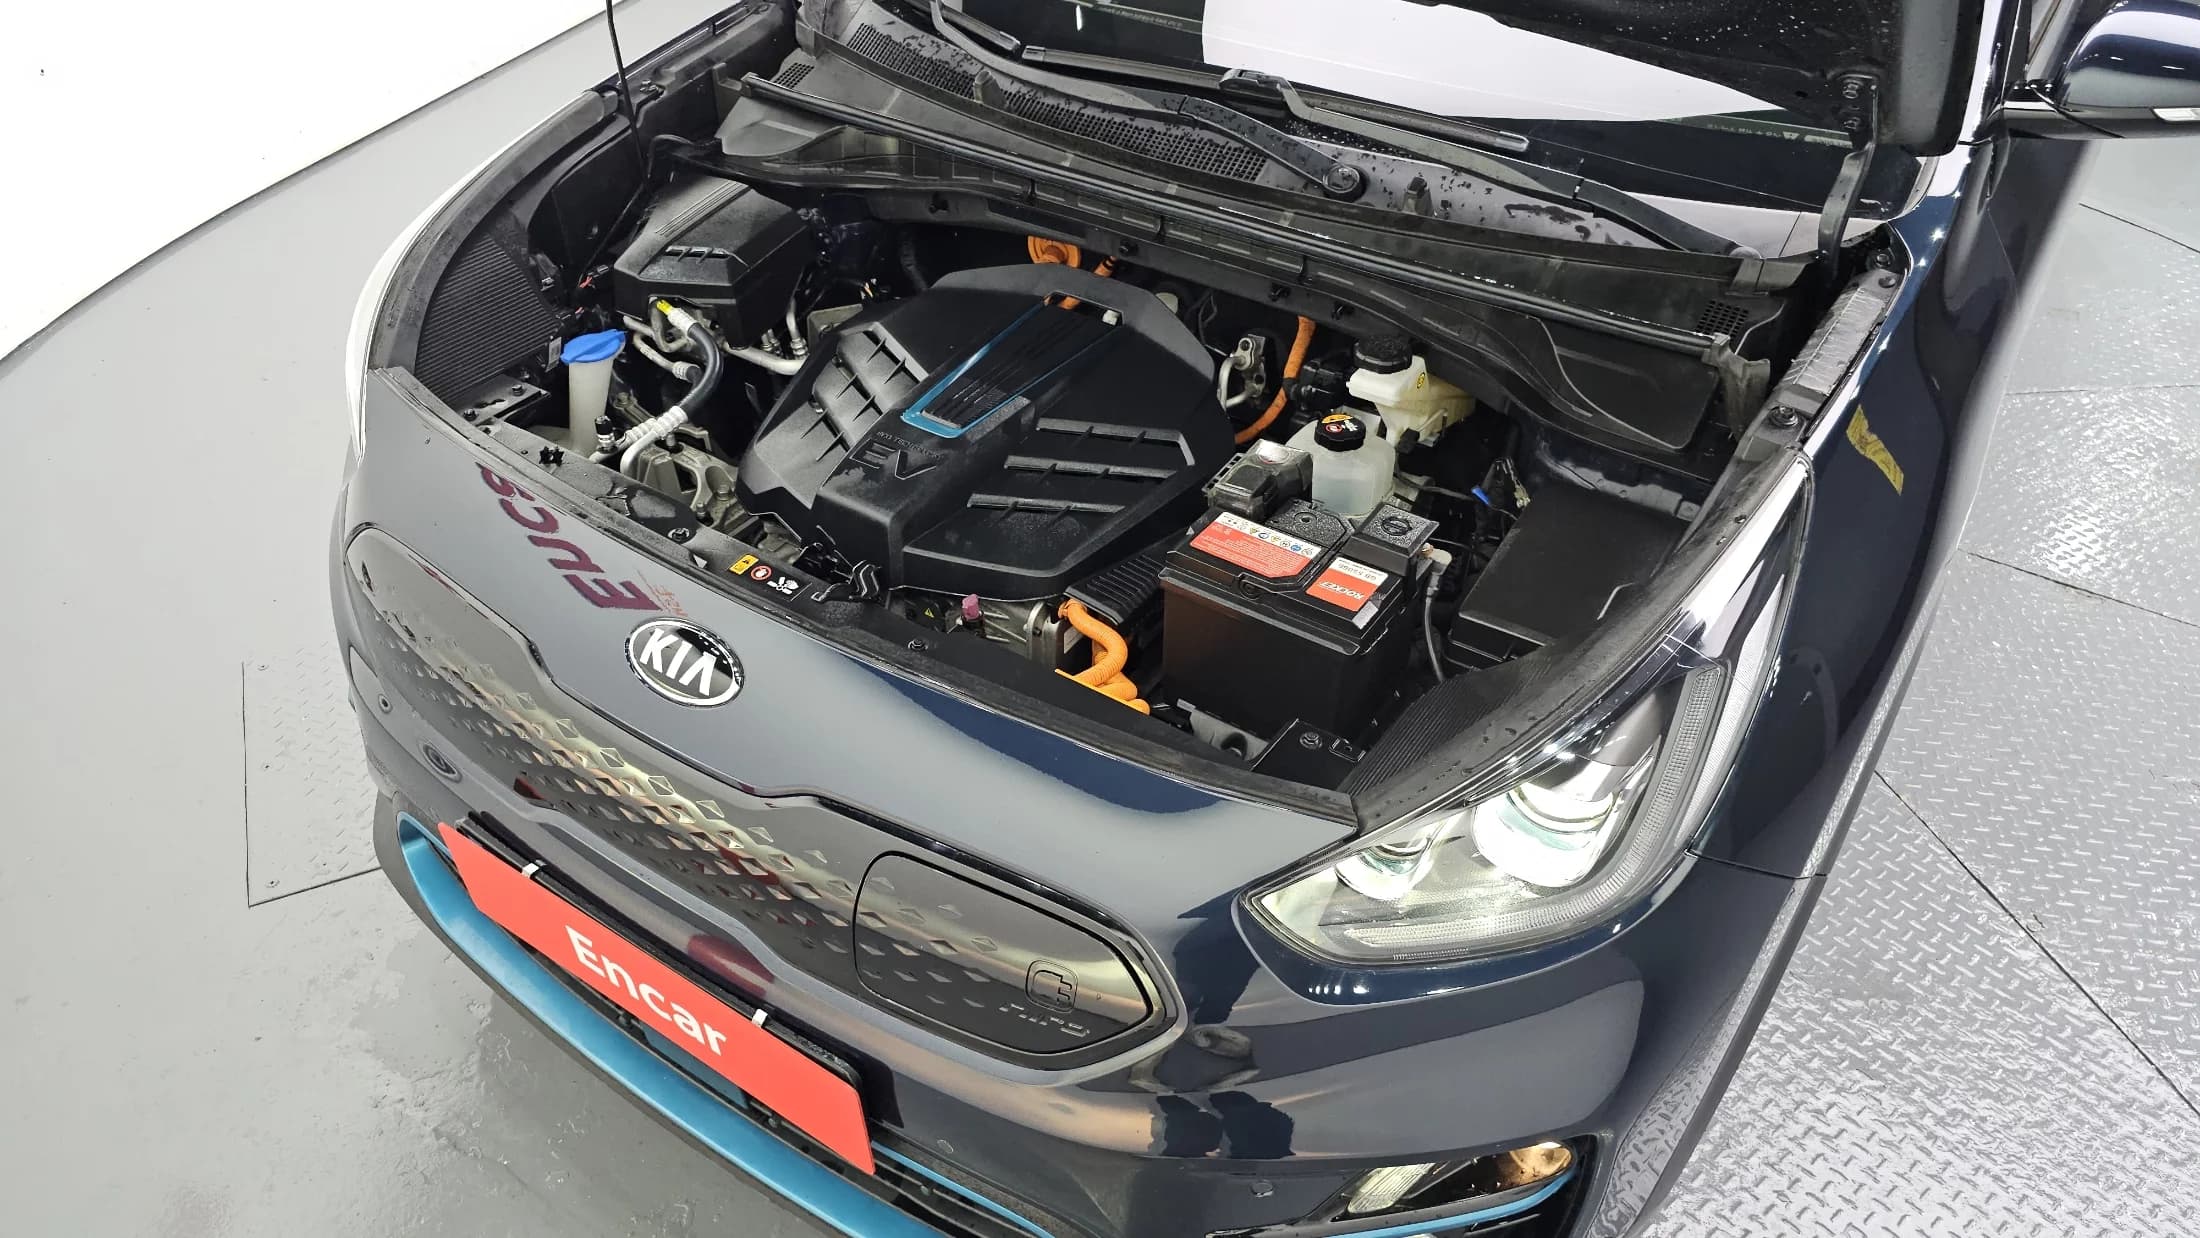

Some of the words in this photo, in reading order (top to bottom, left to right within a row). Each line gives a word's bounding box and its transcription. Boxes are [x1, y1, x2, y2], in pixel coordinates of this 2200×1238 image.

[849, 438, 937, 480] EV
[1319, 580, 1364, 600] ROCKET
[639, 627, 718, 696] KIA
[564, 924, 727, 1057] Encar
